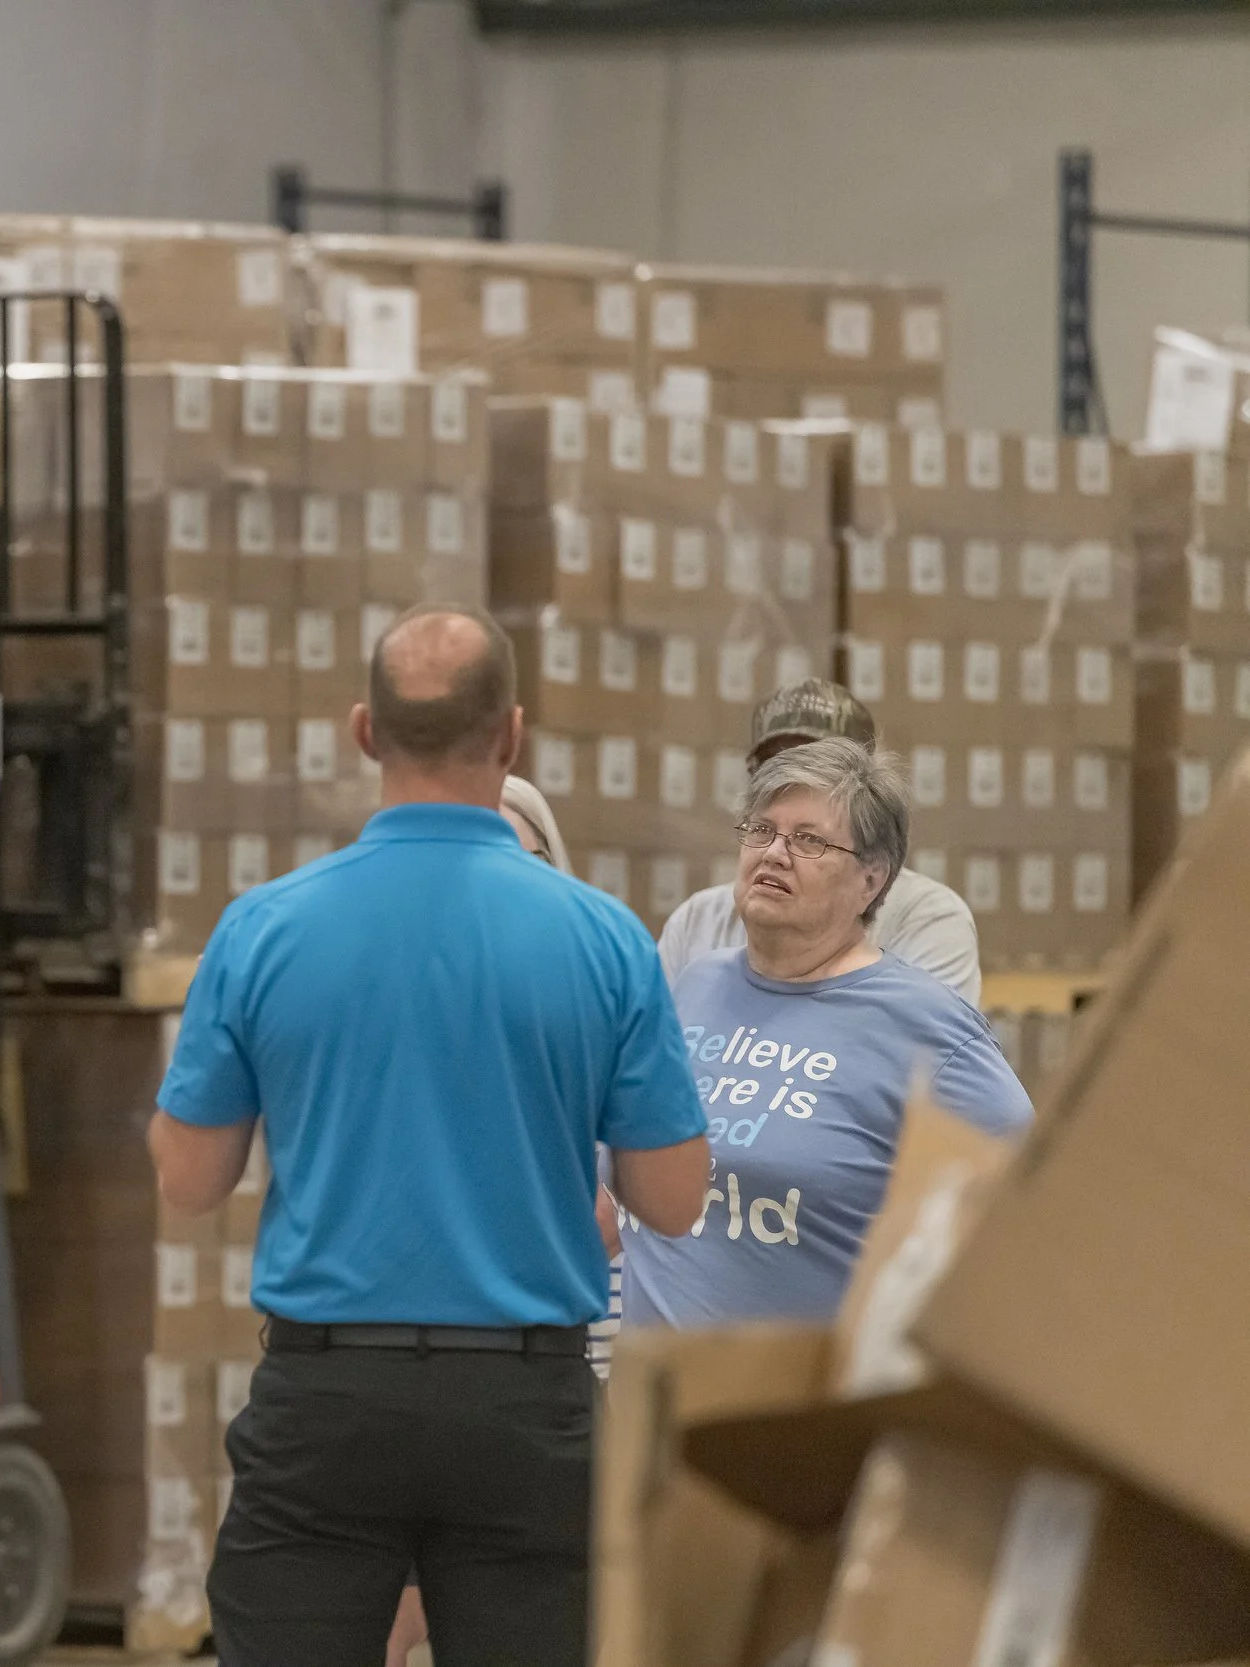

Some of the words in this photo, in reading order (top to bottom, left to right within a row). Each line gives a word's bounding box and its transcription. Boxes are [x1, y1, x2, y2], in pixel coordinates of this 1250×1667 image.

[683, 1026, 837, 1080] Believe
[696, 1076, 759, 1105] ere
[769, 1077, 817, 1118] is
[708, 1113, 768, 1147] od
